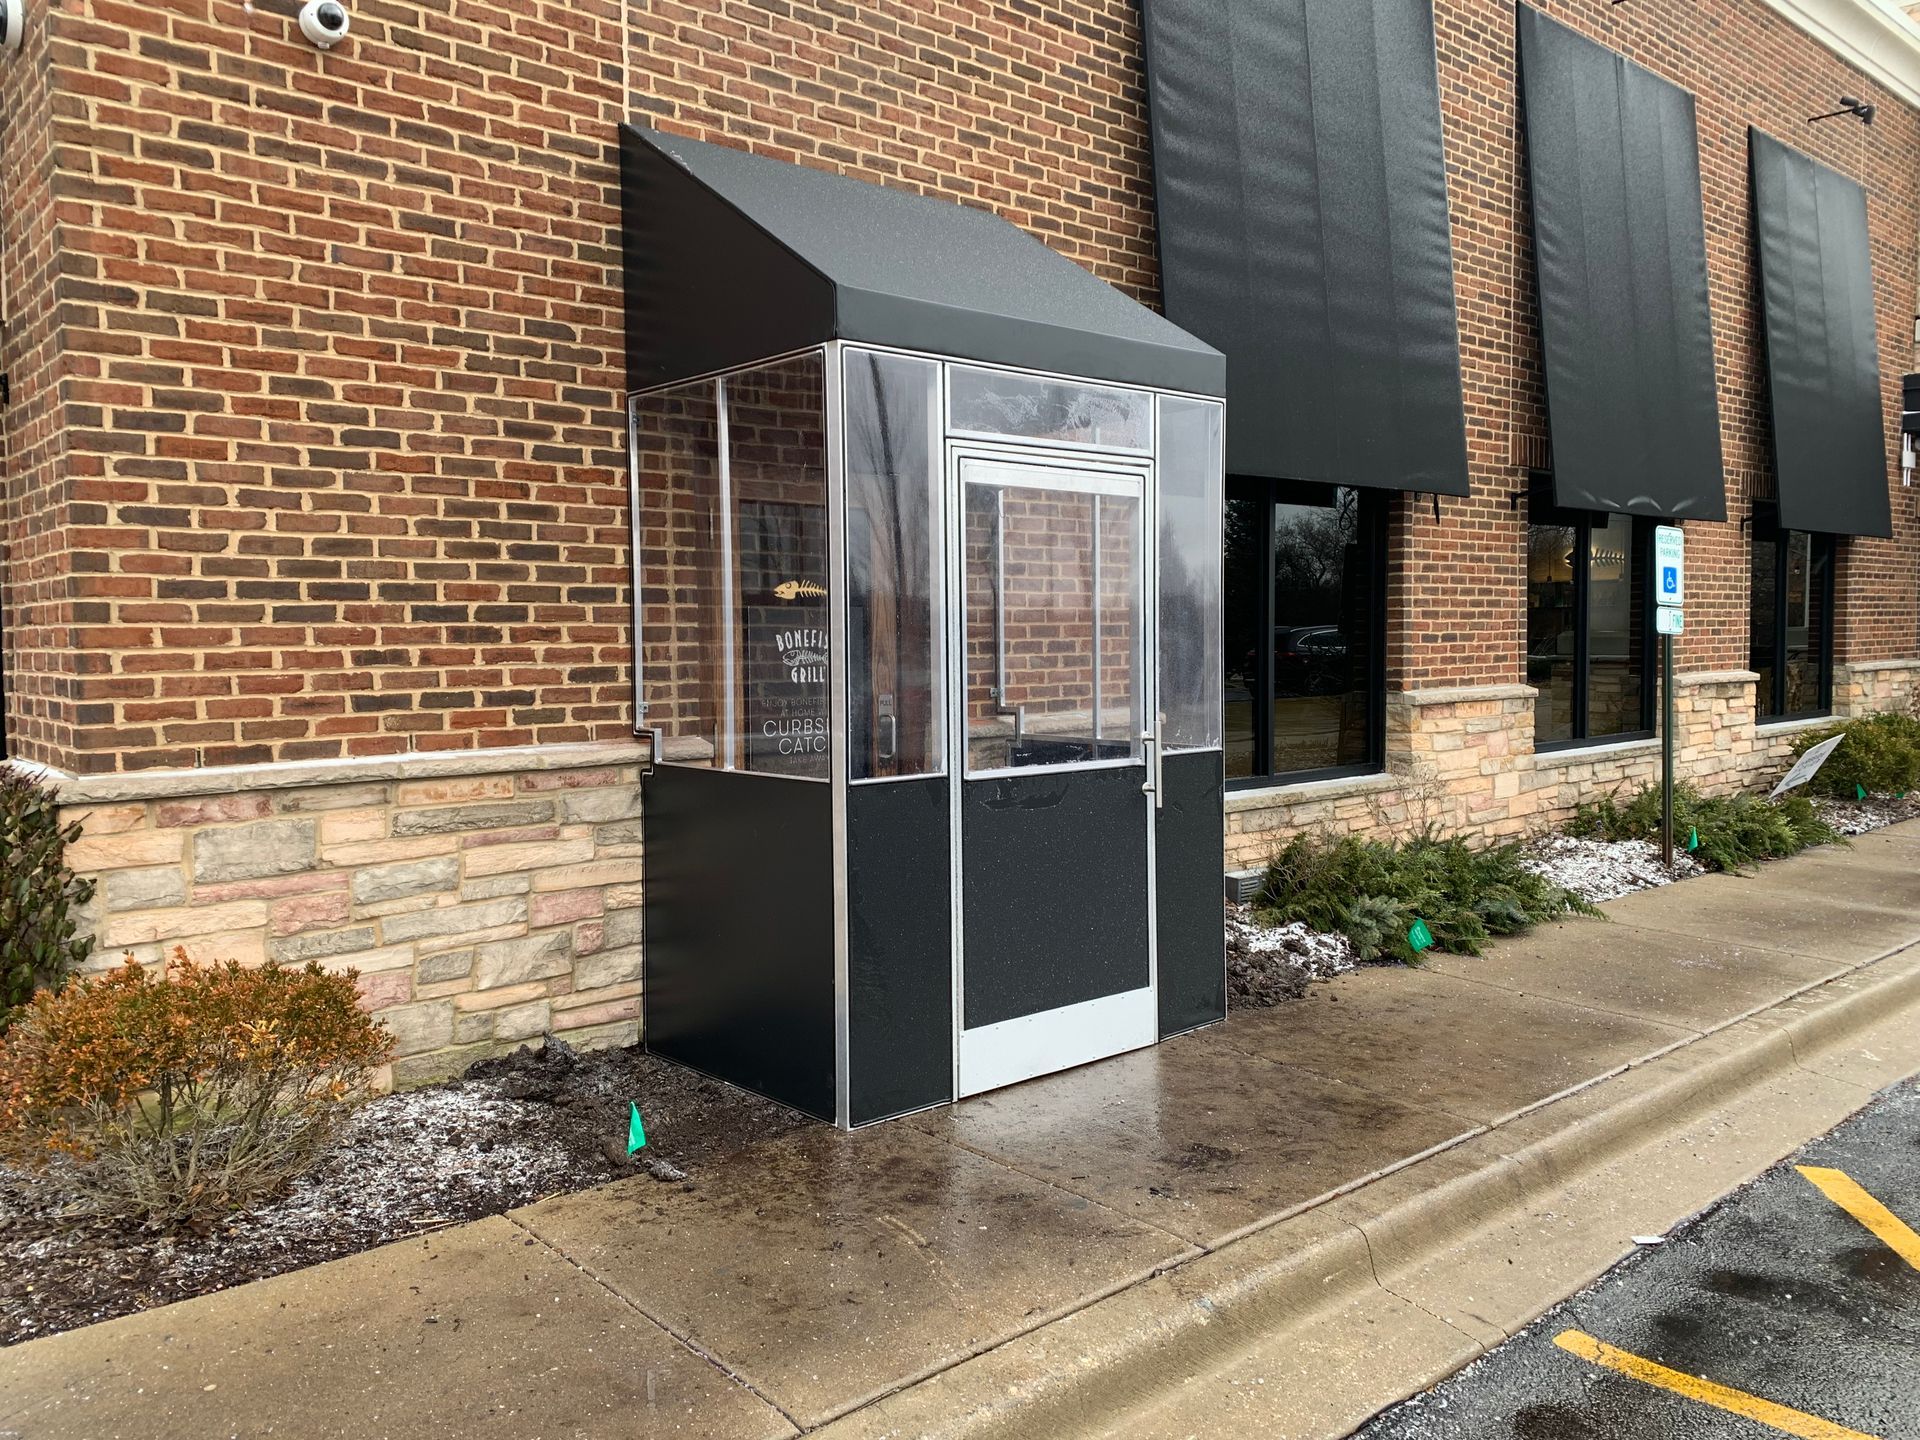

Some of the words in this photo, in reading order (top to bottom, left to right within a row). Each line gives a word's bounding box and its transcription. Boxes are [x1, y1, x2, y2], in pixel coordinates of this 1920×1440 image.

[1658, 533, 1682, 546] RESERVED
[1660, 547, 1681, 559] PARKING
[791, 666, 825, 684] GRILL
[791, 708, 815, 717] HOME
